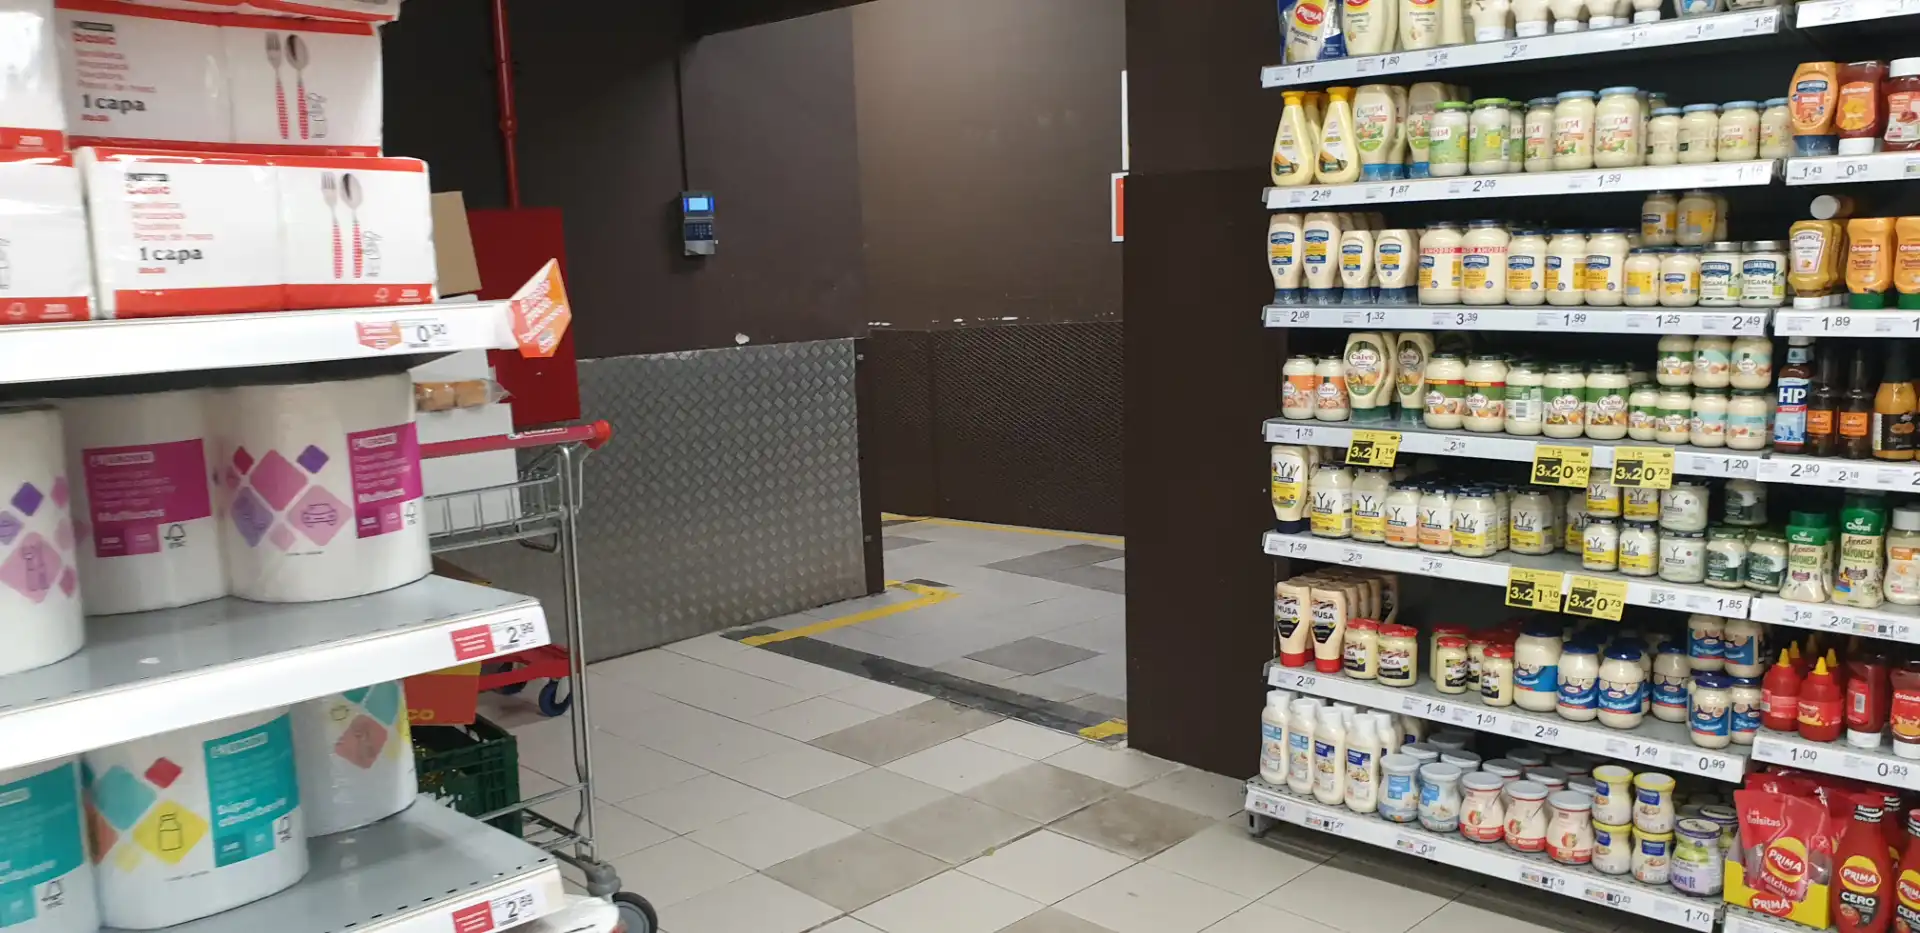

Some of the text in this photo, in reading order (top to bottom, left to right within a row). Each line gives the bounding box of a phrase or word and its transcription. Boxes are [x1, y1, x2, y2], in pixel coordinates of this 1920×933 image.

[94, 96, 147, 115] capa
[152, 248, 203, 265] capa
[1821, 316, 1851, 331] 1,89
[1778, 387, 1807, 404] HP
[1351, 446, 1374, 458] 3x2
[1536, 465, 1561, 478] 3x2
[1723, 459, 1749, 472] 1,20
[1790, 463, 1820, 477] 2,90
[1616, 467, 1642, 480] 3x2
[1510, 586, 1534, 601] 3x2
[1570, 594, 1595, 608] 3x2
[1277, 604, 1299, 616] MUSA
[1311, 610, 1335, 621] MUSA
[1768, 849, 1803, 873] PRIMA
[1761, 871, 1797, 896] Ketchup
[1843, 868, 1877, 884] PRIMA
[1900, 881, 1920, 900] PRIM
[1751, 897, 1791, 911] PRIMA
[1841, 891, 1876, 907] CERO
